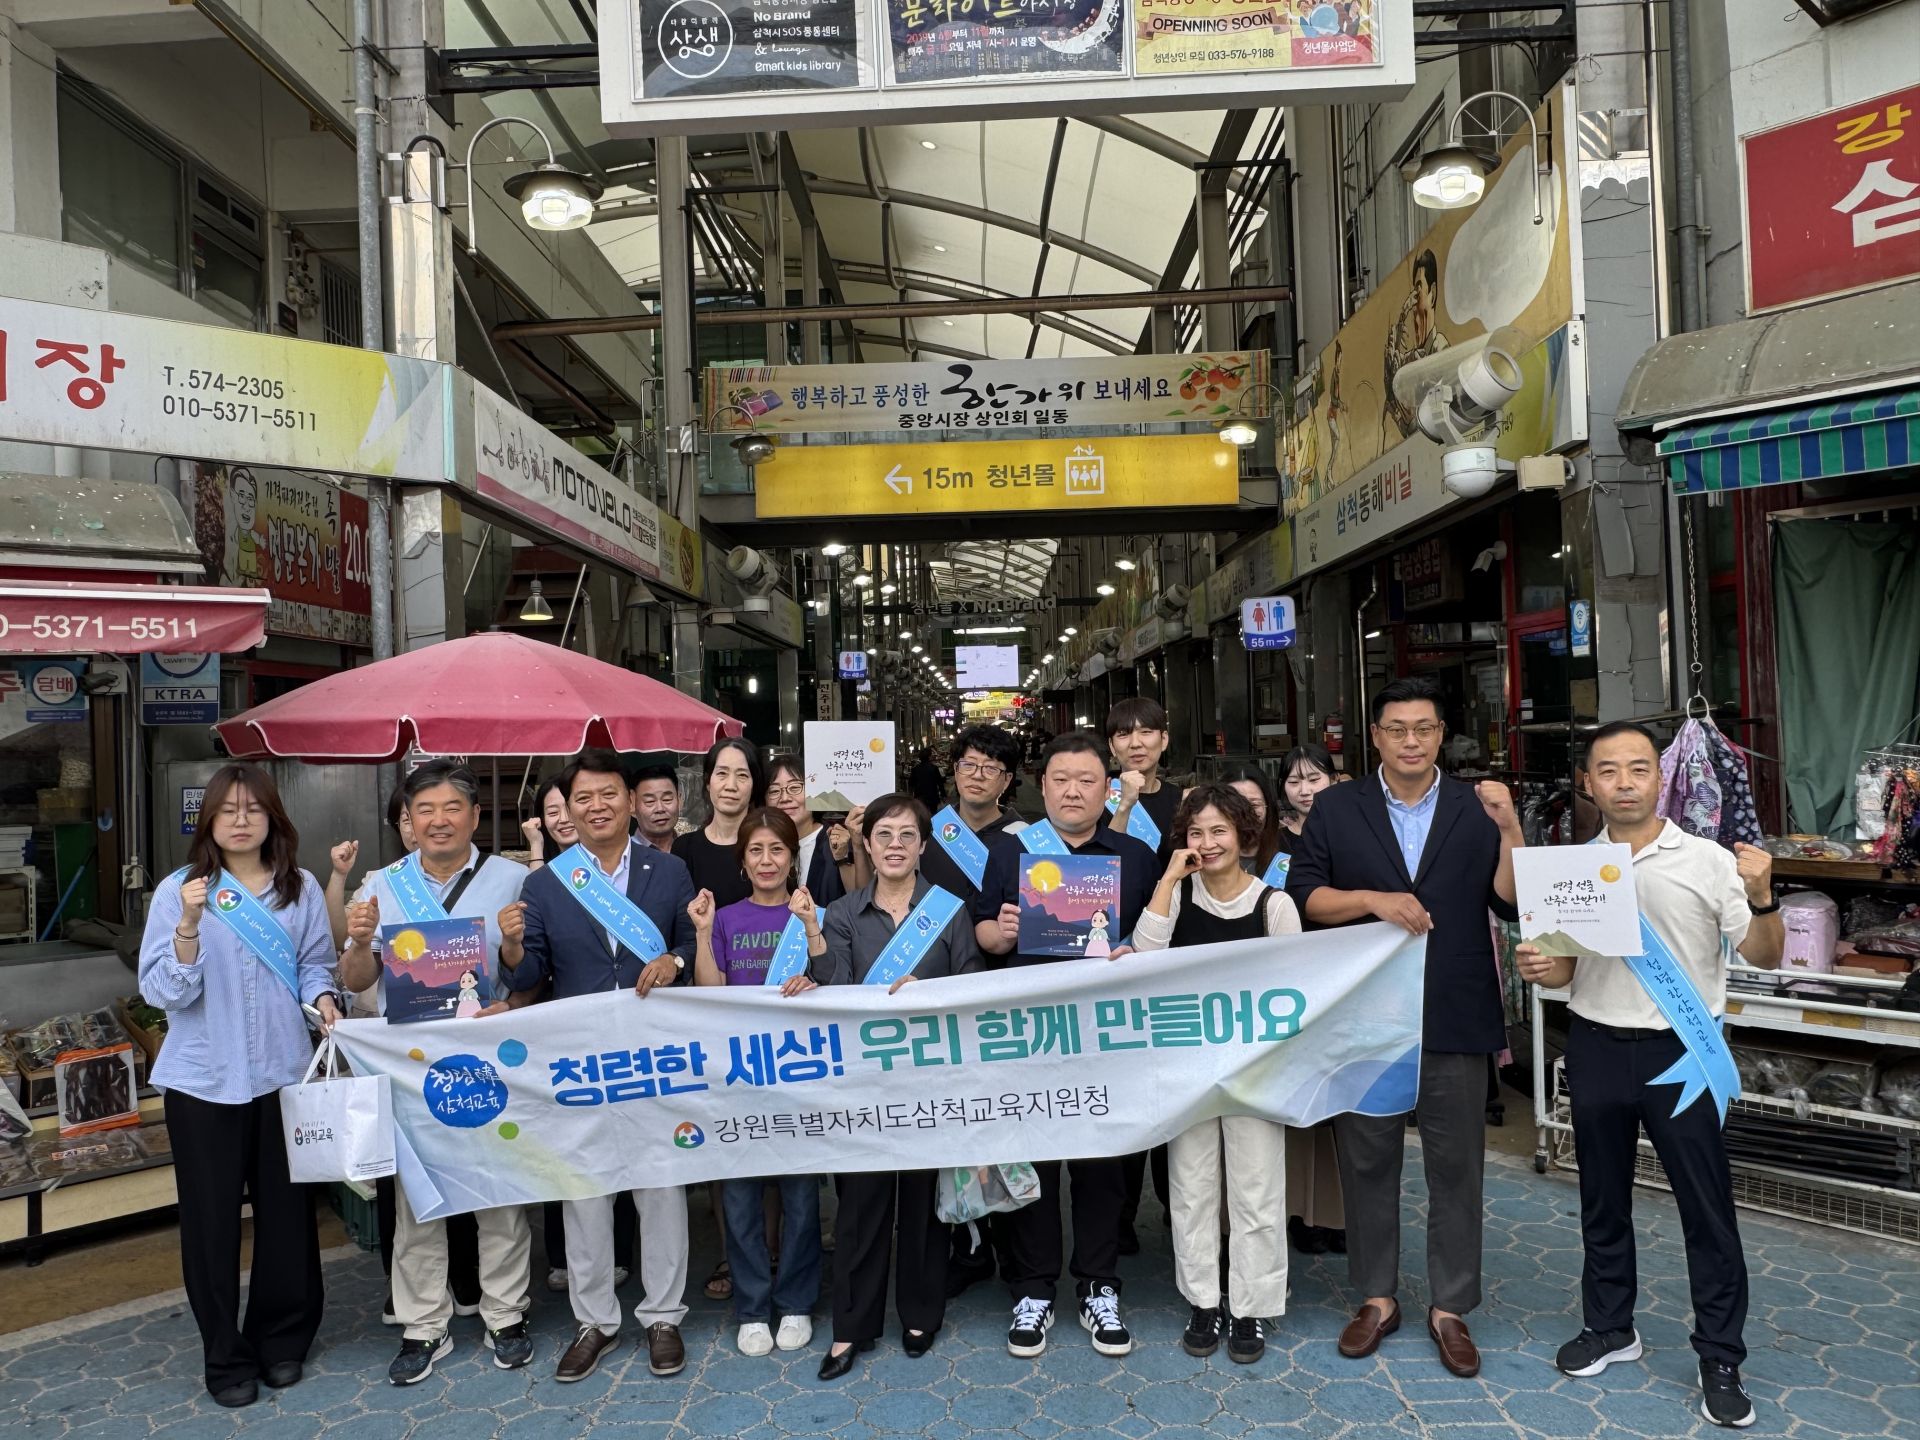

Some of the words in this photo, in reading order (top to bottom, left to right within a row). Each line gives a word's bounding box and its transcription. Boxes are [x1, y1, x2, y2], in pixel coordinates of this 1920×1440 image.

[753, 11, 771, 22] No
[773, 10, 811, 21] Brand
[1152, 18, 1228, 33] OPENNING
[1231, 12, 1273, 30] SOON
[755, 42, 768, 56] &
[1207, 48, 1275, 61] 033-576-9188
[786, 60, 808, 71] kids
[809, 60, 841, 72] library
[0, 329, 126, 410] 장
[790, 382, 868, 409] 행복하고
[871, 382, 931, 408] 풍성한
[1093, 377, 1173, 402] 보내세요
[162, 395, 318, 432] 010-5371-5511
[897, 410, 972, 429] 중앙시장
[975, 409, 1029, 427] 상인회
[1034, 408, 1069, 425] 일동
[922, 467, 974, 490] 15m
[986, 460, 1057, 489] 청년몰
[1336, 454, 1413, 536] 삼척동해비닐
[1003, 592, 1057, 613] Brand
[36, 676, 74, 693] 담배
[155, 687, 207, 701] KTRA
[1553, 880, 1573, 893] 명절
[1576, 879, 1595, 893] 선물
[1543, 894, 1568, 907] 안주고
[548, 1040, 709, 1108] 청렴한
[726, 1023, 844, 1088] 세상!
[859, 1013, 963, 1072] 우리
[975, 1003, 1082, 1063] 함께
[1094, 986, 1308, 1052] 만들어요
[437, 1089, 501, 1115] 삼척교육
[713, 1084, 1111, 1145] 강원특별자치도삼척교육지원청
